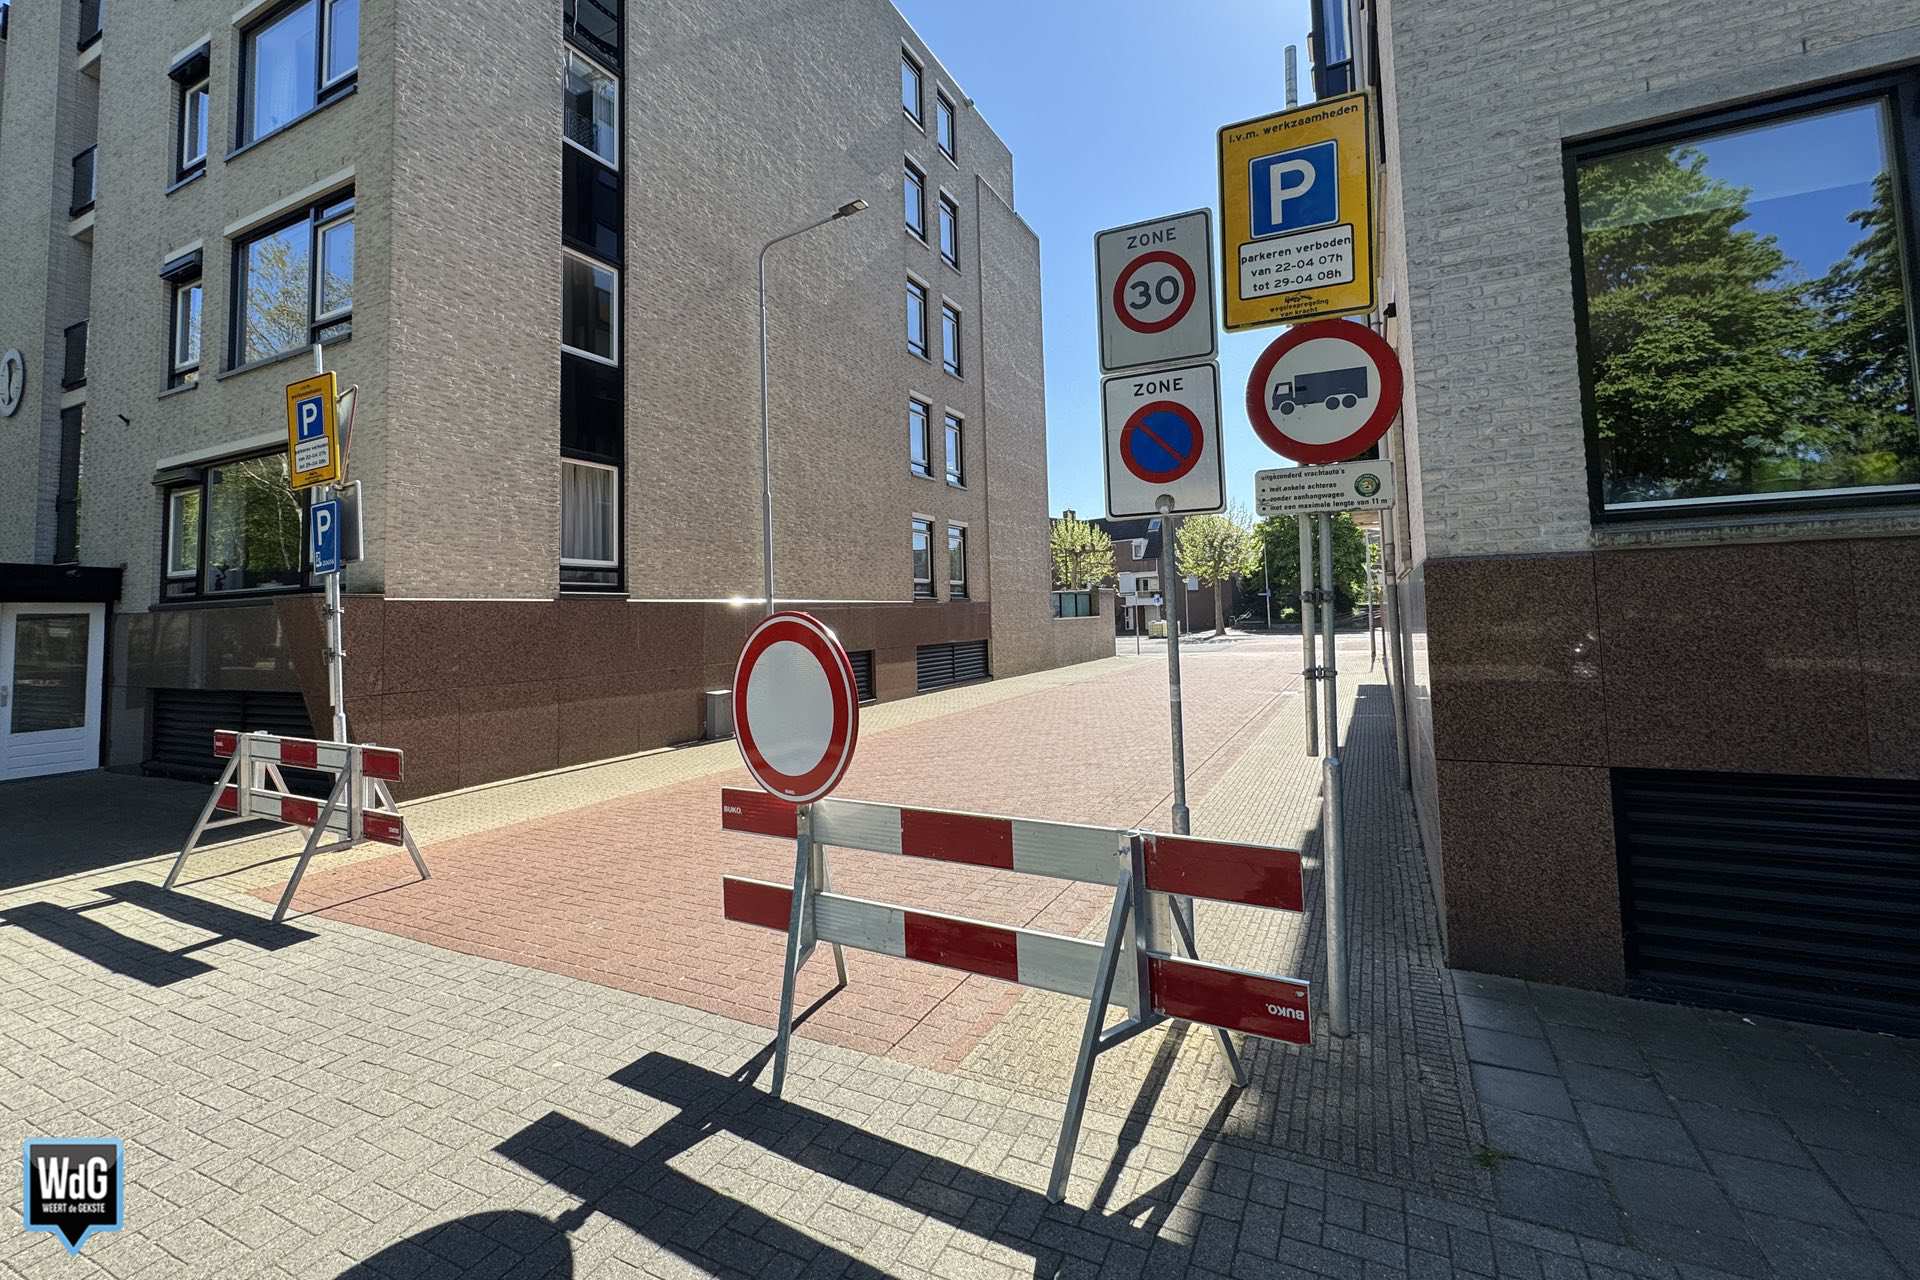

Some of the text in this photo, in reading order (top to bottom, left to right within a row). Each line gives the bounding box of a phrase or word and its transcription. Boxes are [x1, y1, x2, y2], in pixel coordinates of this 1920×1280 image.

[1263, 104, 1358, 135] werkzaamheden
[1270, 159, 1316, 226] P
[1126, 228, 1176, 250] ZONE
[1241, 237, 1351, 265] parkeren verboden
[1251, 253, 1343, 277] van 22-04 07h
[1129, 275, 1180, 310] 30
[1253, 269, 1342, 292] tot 29-04 08h
[1133, 378, 1184, 397] ZONE
[302, 402, 318, 436] P
[316, 509, 331, 546] P
